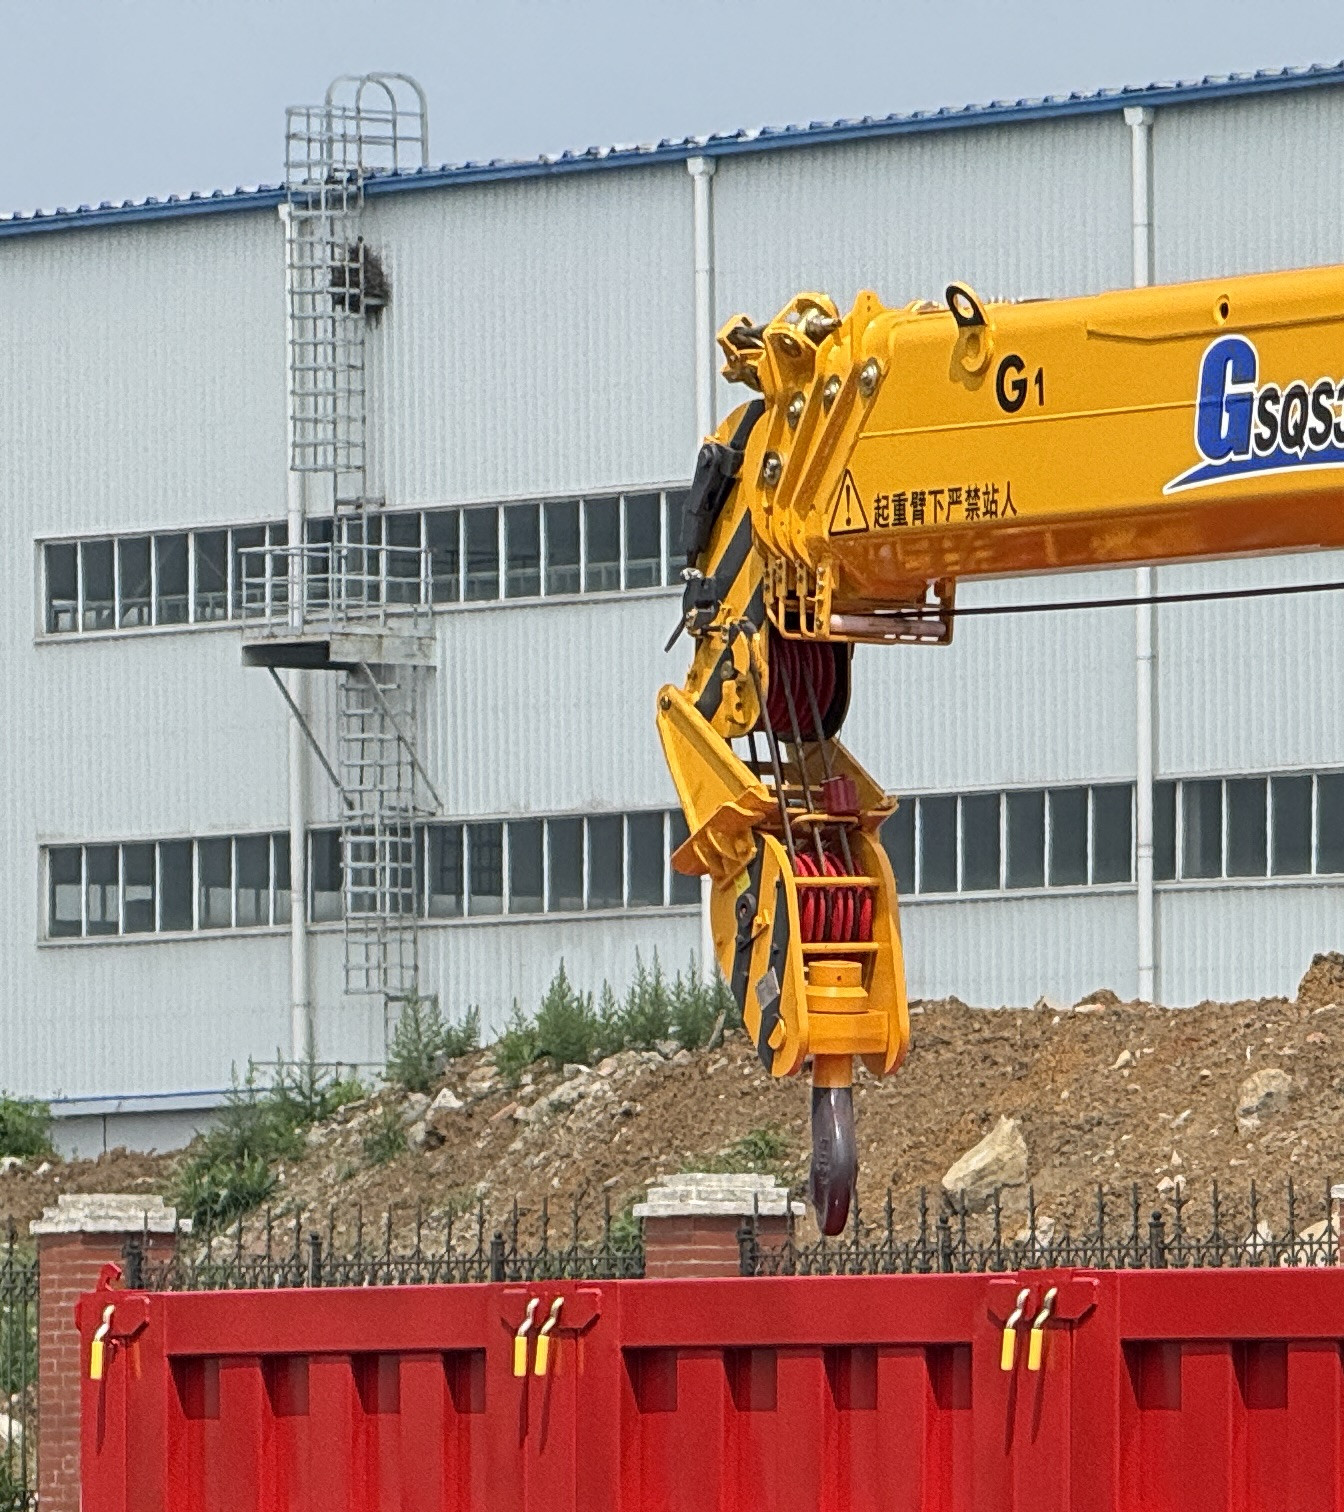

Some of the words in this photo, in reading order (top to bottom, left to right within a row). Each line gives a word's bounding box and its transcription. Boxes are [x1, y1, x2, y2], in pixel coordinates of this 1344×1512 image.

[873, 480, 1018, 529] 起重臂下严禁站人
